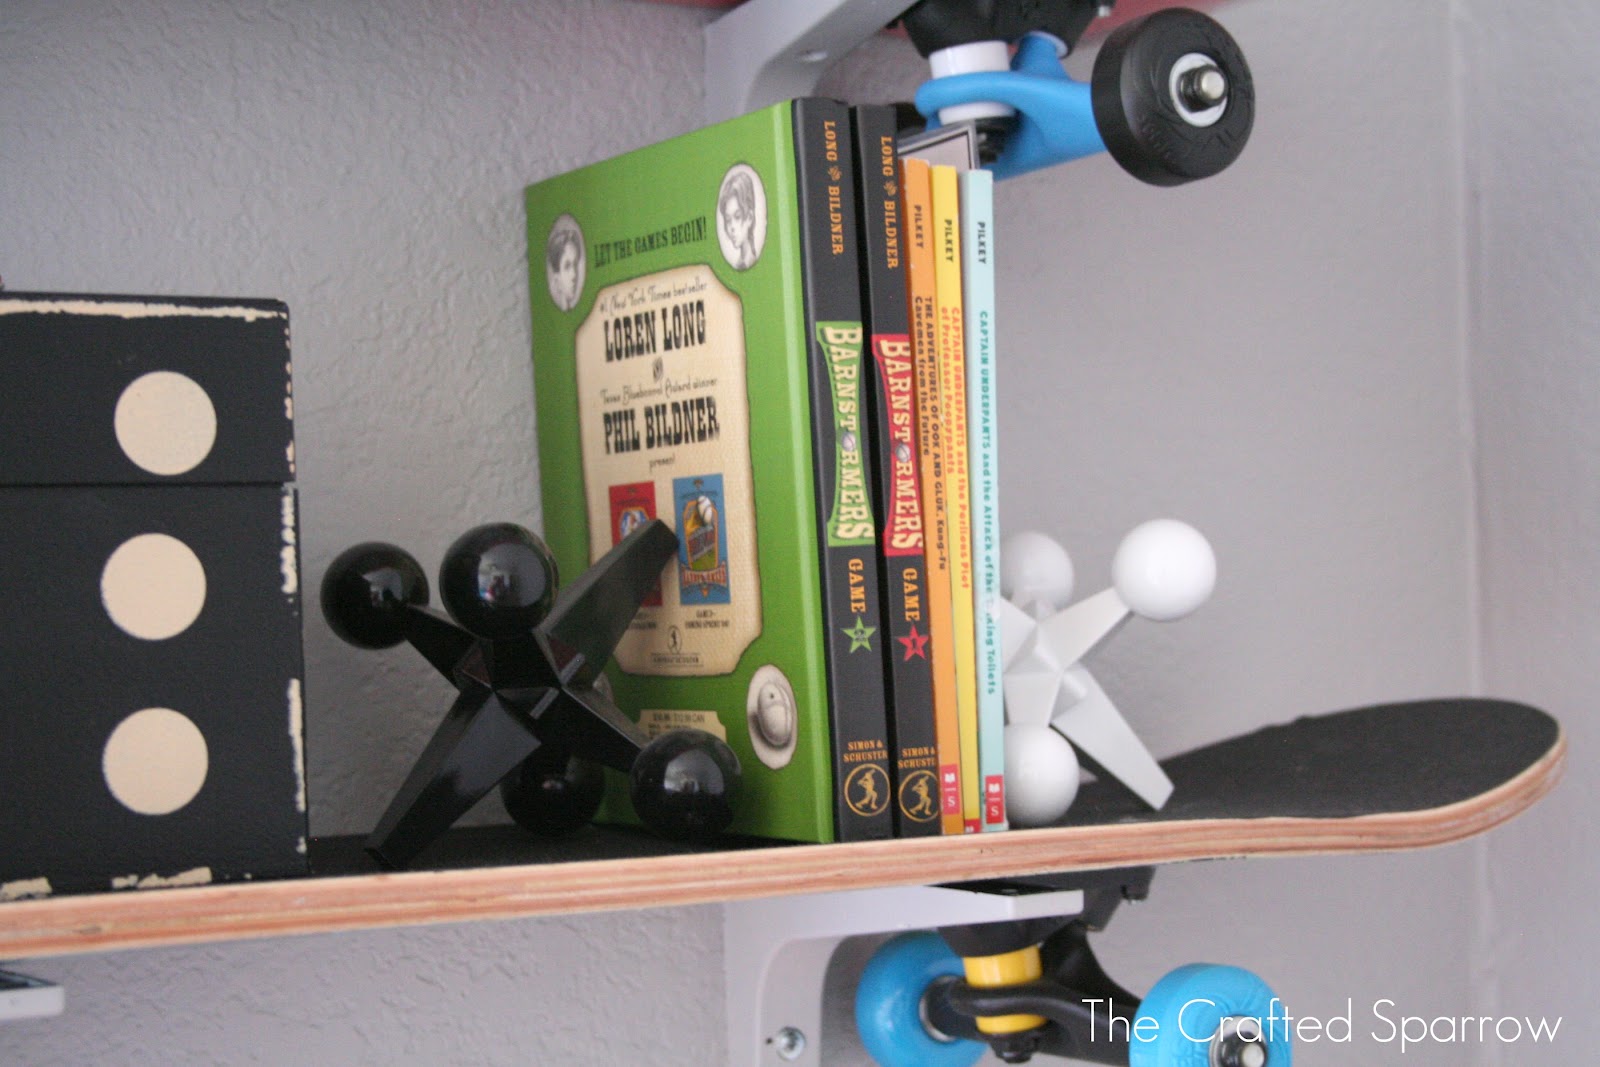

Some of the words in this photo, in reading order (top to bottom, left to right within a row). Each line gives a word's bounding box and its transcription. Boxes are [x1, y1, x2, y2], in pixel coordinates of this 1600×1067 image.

[824, 120, 838, 162] LONG
[880, 135, 894, 177] LONG
[828, 185, 844, 256] BILDNER
[884, 200, 899, 270] BILDNER
[914, 204, 924, 249] PILKEY
[944, 219, 954, 263] PILKEY
[594, 242, 611, 268] LET
[613, 239, 632, 261] THE
[634, 229, 669, 254] GAMES
[671, 216, 707, 246] BEGIN!
[977, 221, 986, 265] PILKEY
[915, 296, 925, 355] Cavemen
[924, 297, 933, 319] THE
[941, 306, 950, 321] of
[604, 310, 656, 363] LOREN
[662, 299, 706, 351] LONG
[951, 307, 962, 362] CAPTAIN
[980, 310, 989, 365] CAPTAIN
[918, 358, 928, 388] from
[925, 322, 938, 402] ADVENTURES
[941, 324, 952, 391] Professor
[920, 391, 930, 412] the
[929, 405, 939, 420] OF
[954, 365, 966, 447] UNDERPANTS
[981, 368, 991, 449] UNDERPANTS
[603, 407, 641, 455] PHIL
[644, 395, 720, 450] BILDNER
[921, 415, 931, 456] Future
[931, 423, 941, 449] OOK
[933, 452, 942, 478] AND
[956, 451, 966, 475] and
[982, 453, 992, 477] and
[957, 478, 967, 500] the
[983, 480, 993, 501] the
[936, 520, 947, 571] Kung-Fu
[958, 504, 970, 559] Perilous
[983, 505, 993, 551] Attack
[961, 562, 970, 589] Plot
[984, 555, 994, 569] of
[985, 572, 995, 593] the
[848, 557, 867, 614] GAME
[902, 567, 921, 622] GAME
[987, 649, 997, 695] Toilets
[843, 750, 888, 763] SCHUSTER
[847, 740, 875, 751] SIMON
[876, 740, 884, 749] &
[901, 747, 929, 758] SIMON
[948, 795, 956, 808] S
[990, 805, 999, 817] S
